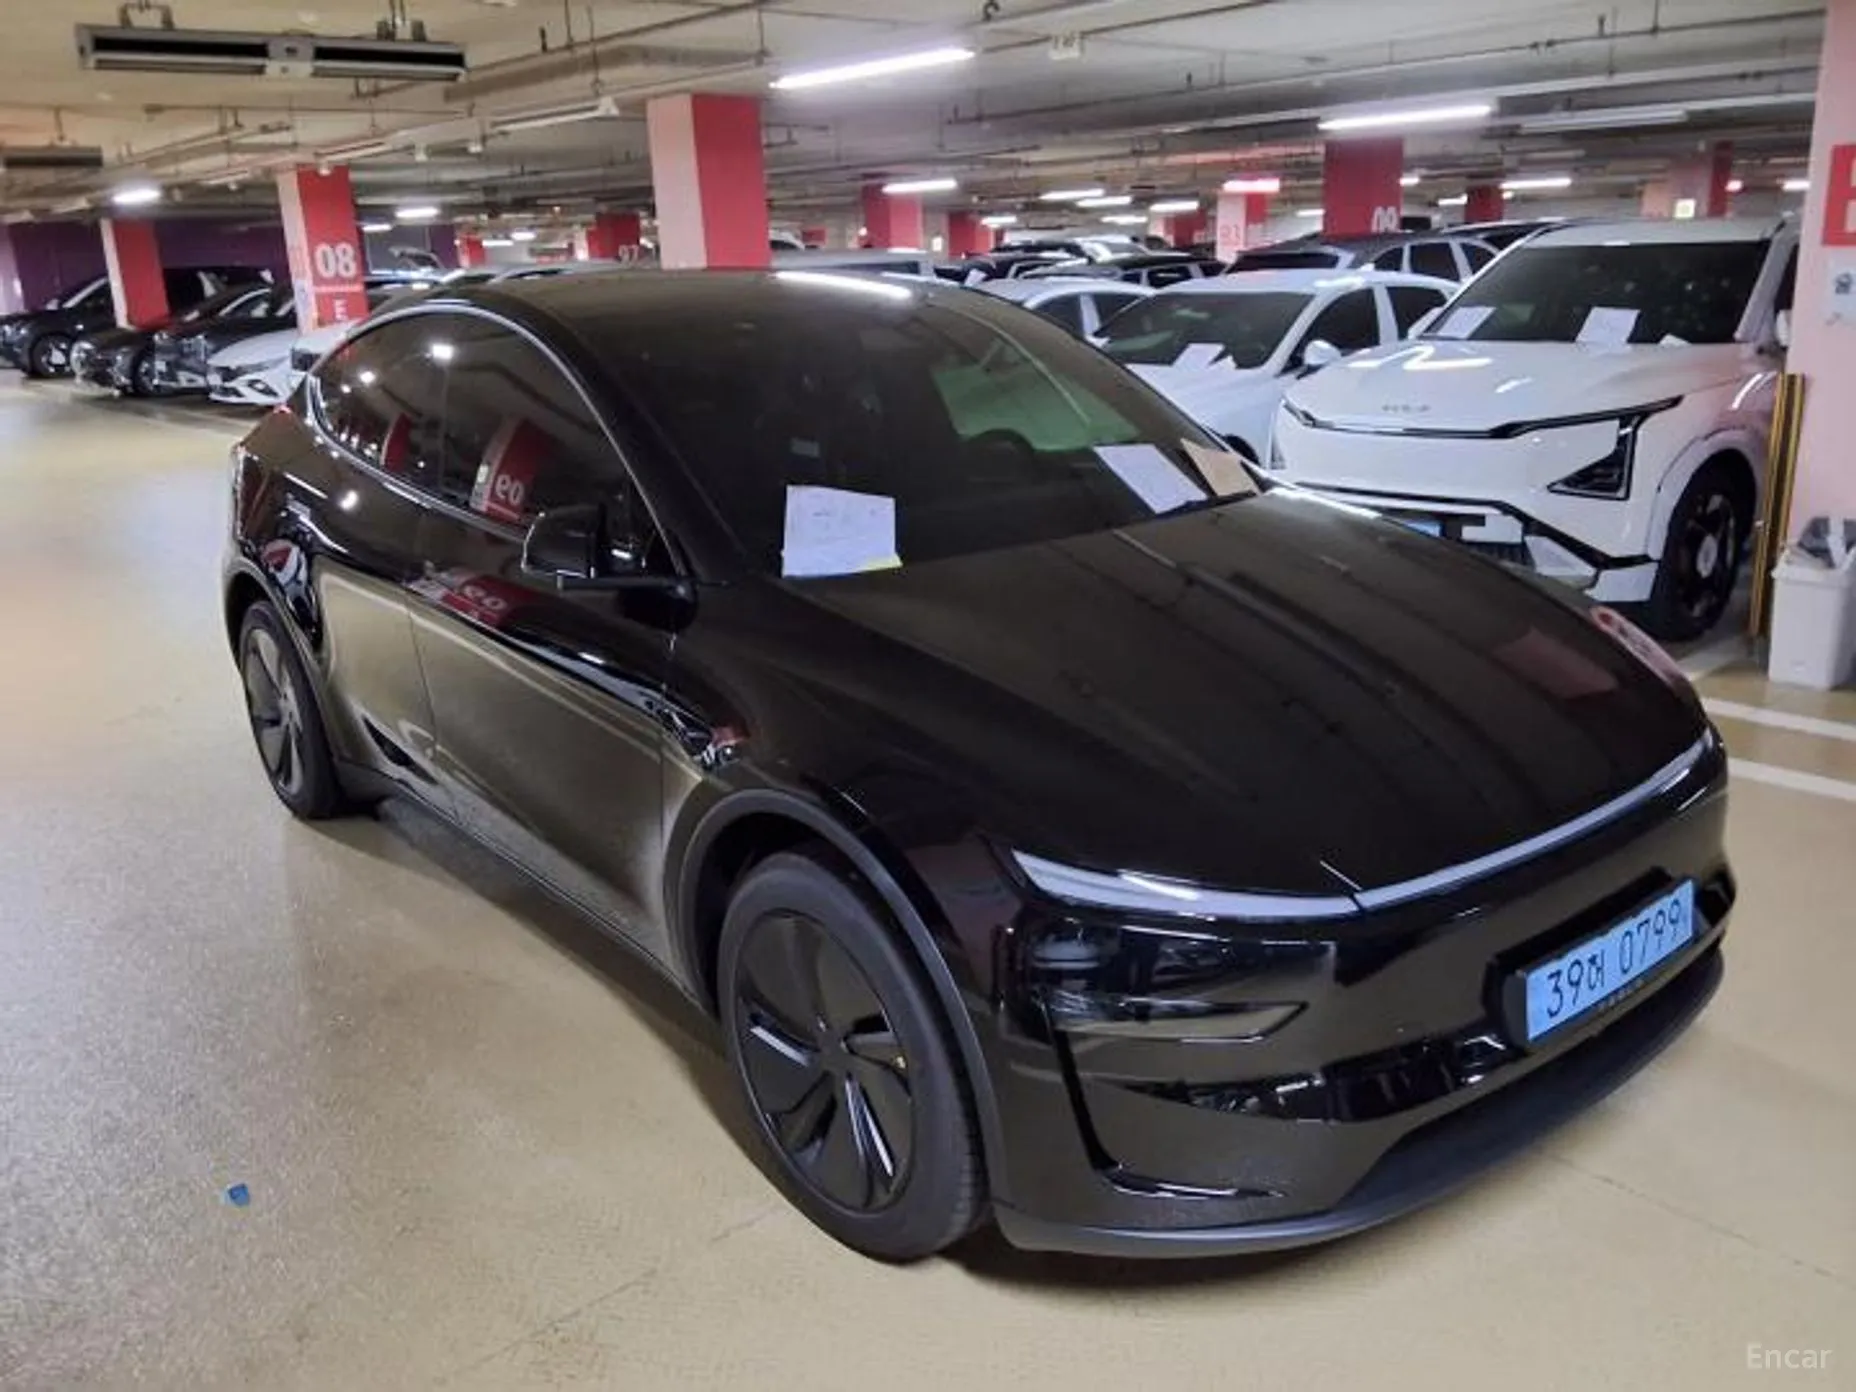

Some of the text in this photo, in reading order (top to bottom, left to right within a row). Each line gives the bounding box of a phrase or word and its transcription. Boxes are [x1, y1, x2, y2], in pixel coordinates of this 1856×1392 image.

[314, 242, 357, 278] 08
[1546, 949, 1605, 1019] 39허
[1618, 898, 1682, 975] 0799
